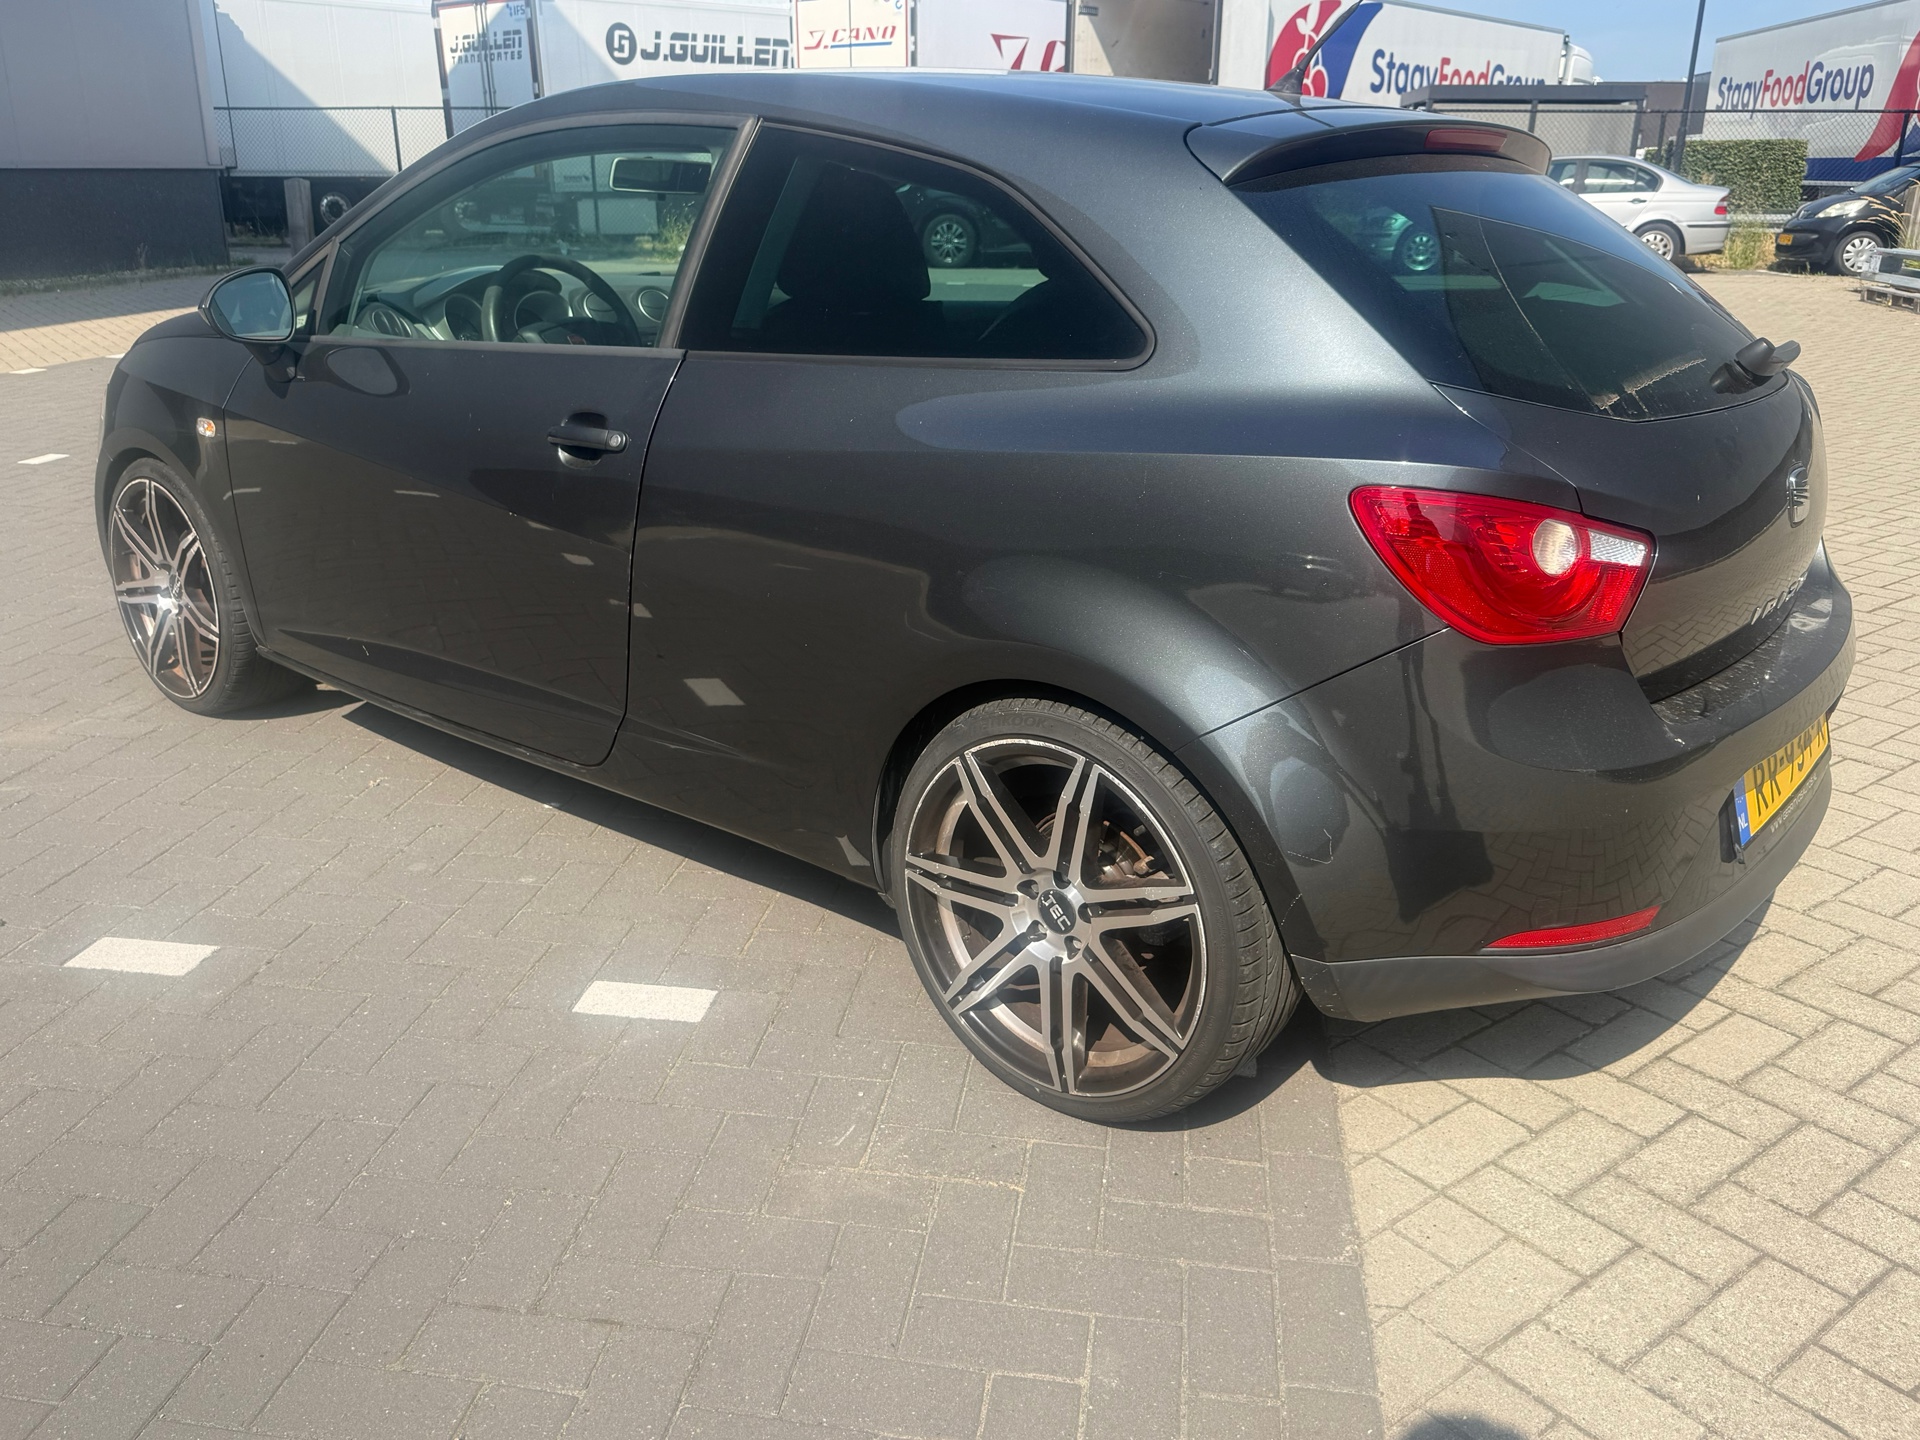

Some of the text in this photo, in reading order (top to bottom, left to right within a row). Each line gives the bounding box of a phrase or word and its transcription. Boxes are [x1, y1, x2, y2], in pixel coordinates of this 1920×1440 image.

[513, 5, 526, 16] IFS
[804, 25, 897, 51] J.CANO
[1370, 48, 1546, 95] StaaFoodG
[1716, 60, 1875, 120] StaayFoodGroup
[1738, 814, 1749, 832] NL
